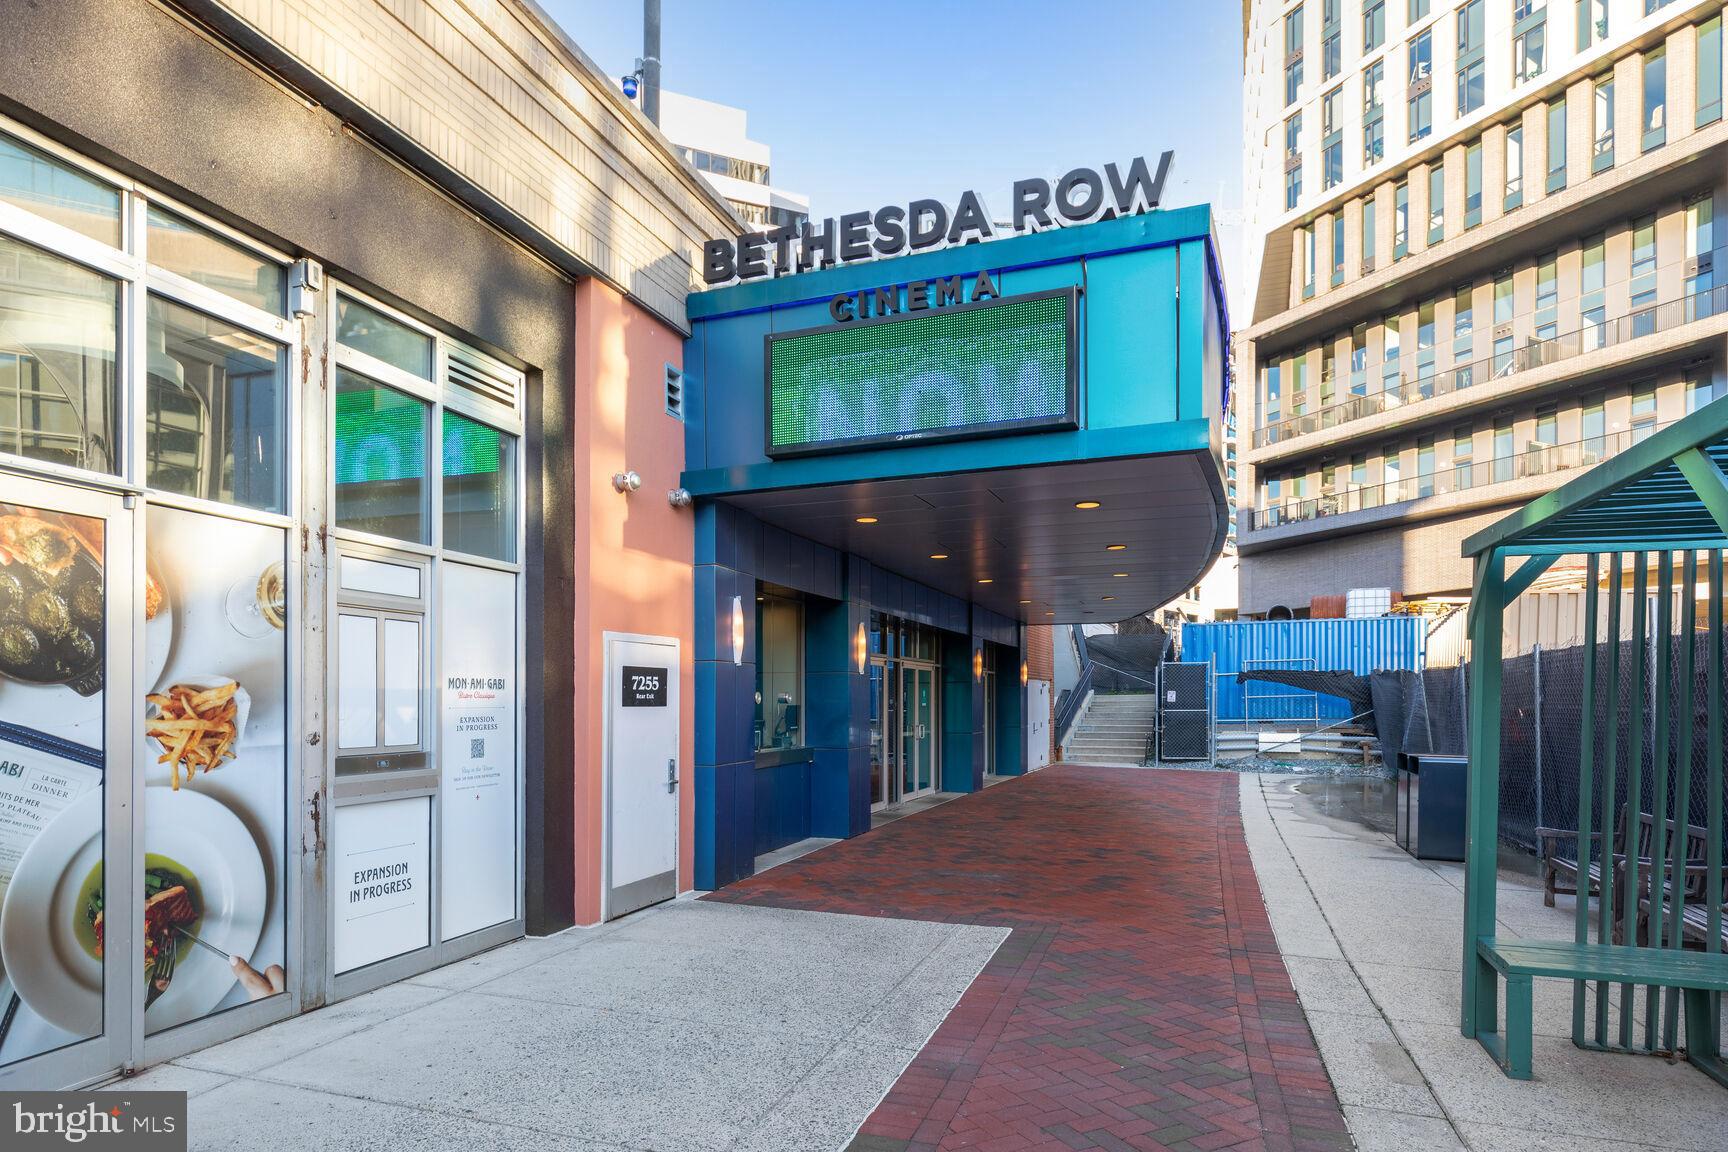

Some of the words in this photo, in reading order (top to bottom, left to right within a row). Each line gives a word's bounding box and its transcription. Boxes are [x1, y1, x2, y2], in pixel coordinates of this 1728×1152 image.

[703, 189, 994, 284] BETHESDA
[1012, 149, 1174, 233] ROW
[829, 270, 999, 322] CINEMA
[631, 675, 660, 691] 7255
[459, 715, 495, 724] EXPANSION
[466, 723, 498, 732] PROGRESS
[0, 760, 25, 778] ABI
[31, 782, 69, 799] DINNER
[14, 795, 24, 804] DE
[25, 798, 41, 808] MER
[354, 862, 408, 885] EXPANSION
[350, 889, 360, 903] IN
[363, 878, 412, 900] PROGRESS
